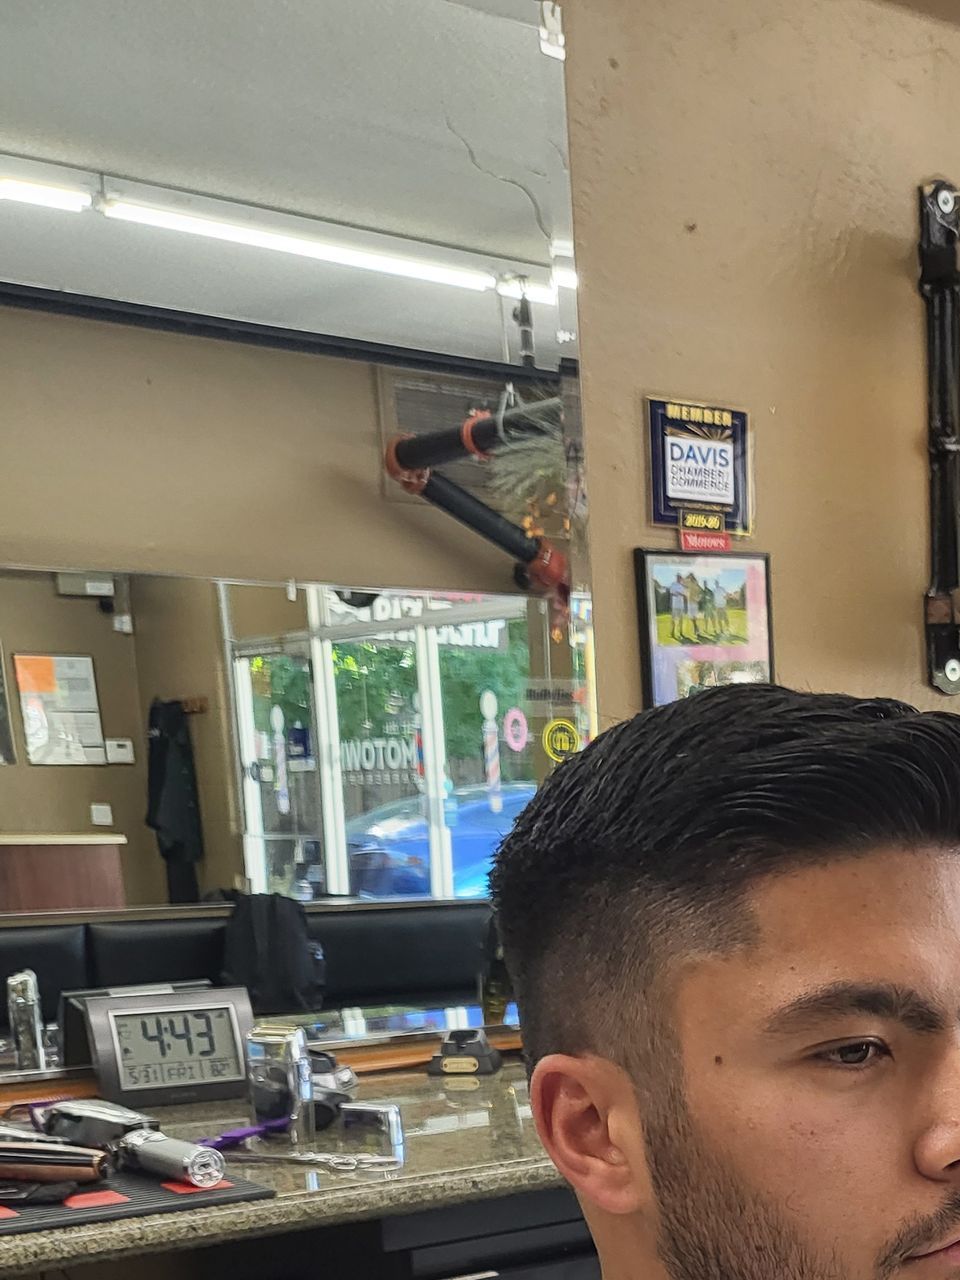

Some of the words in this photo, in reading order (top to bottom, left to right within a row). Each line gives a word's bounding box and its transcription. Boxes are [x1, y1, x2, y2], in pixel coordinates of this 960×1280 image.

[667, 404, 732, 426] MEMBER
[669, 443, 729, 468] DAVIS
[140, 1013, 216, 1058] 4:43
[167, 1066, 197, 1081] FRI
